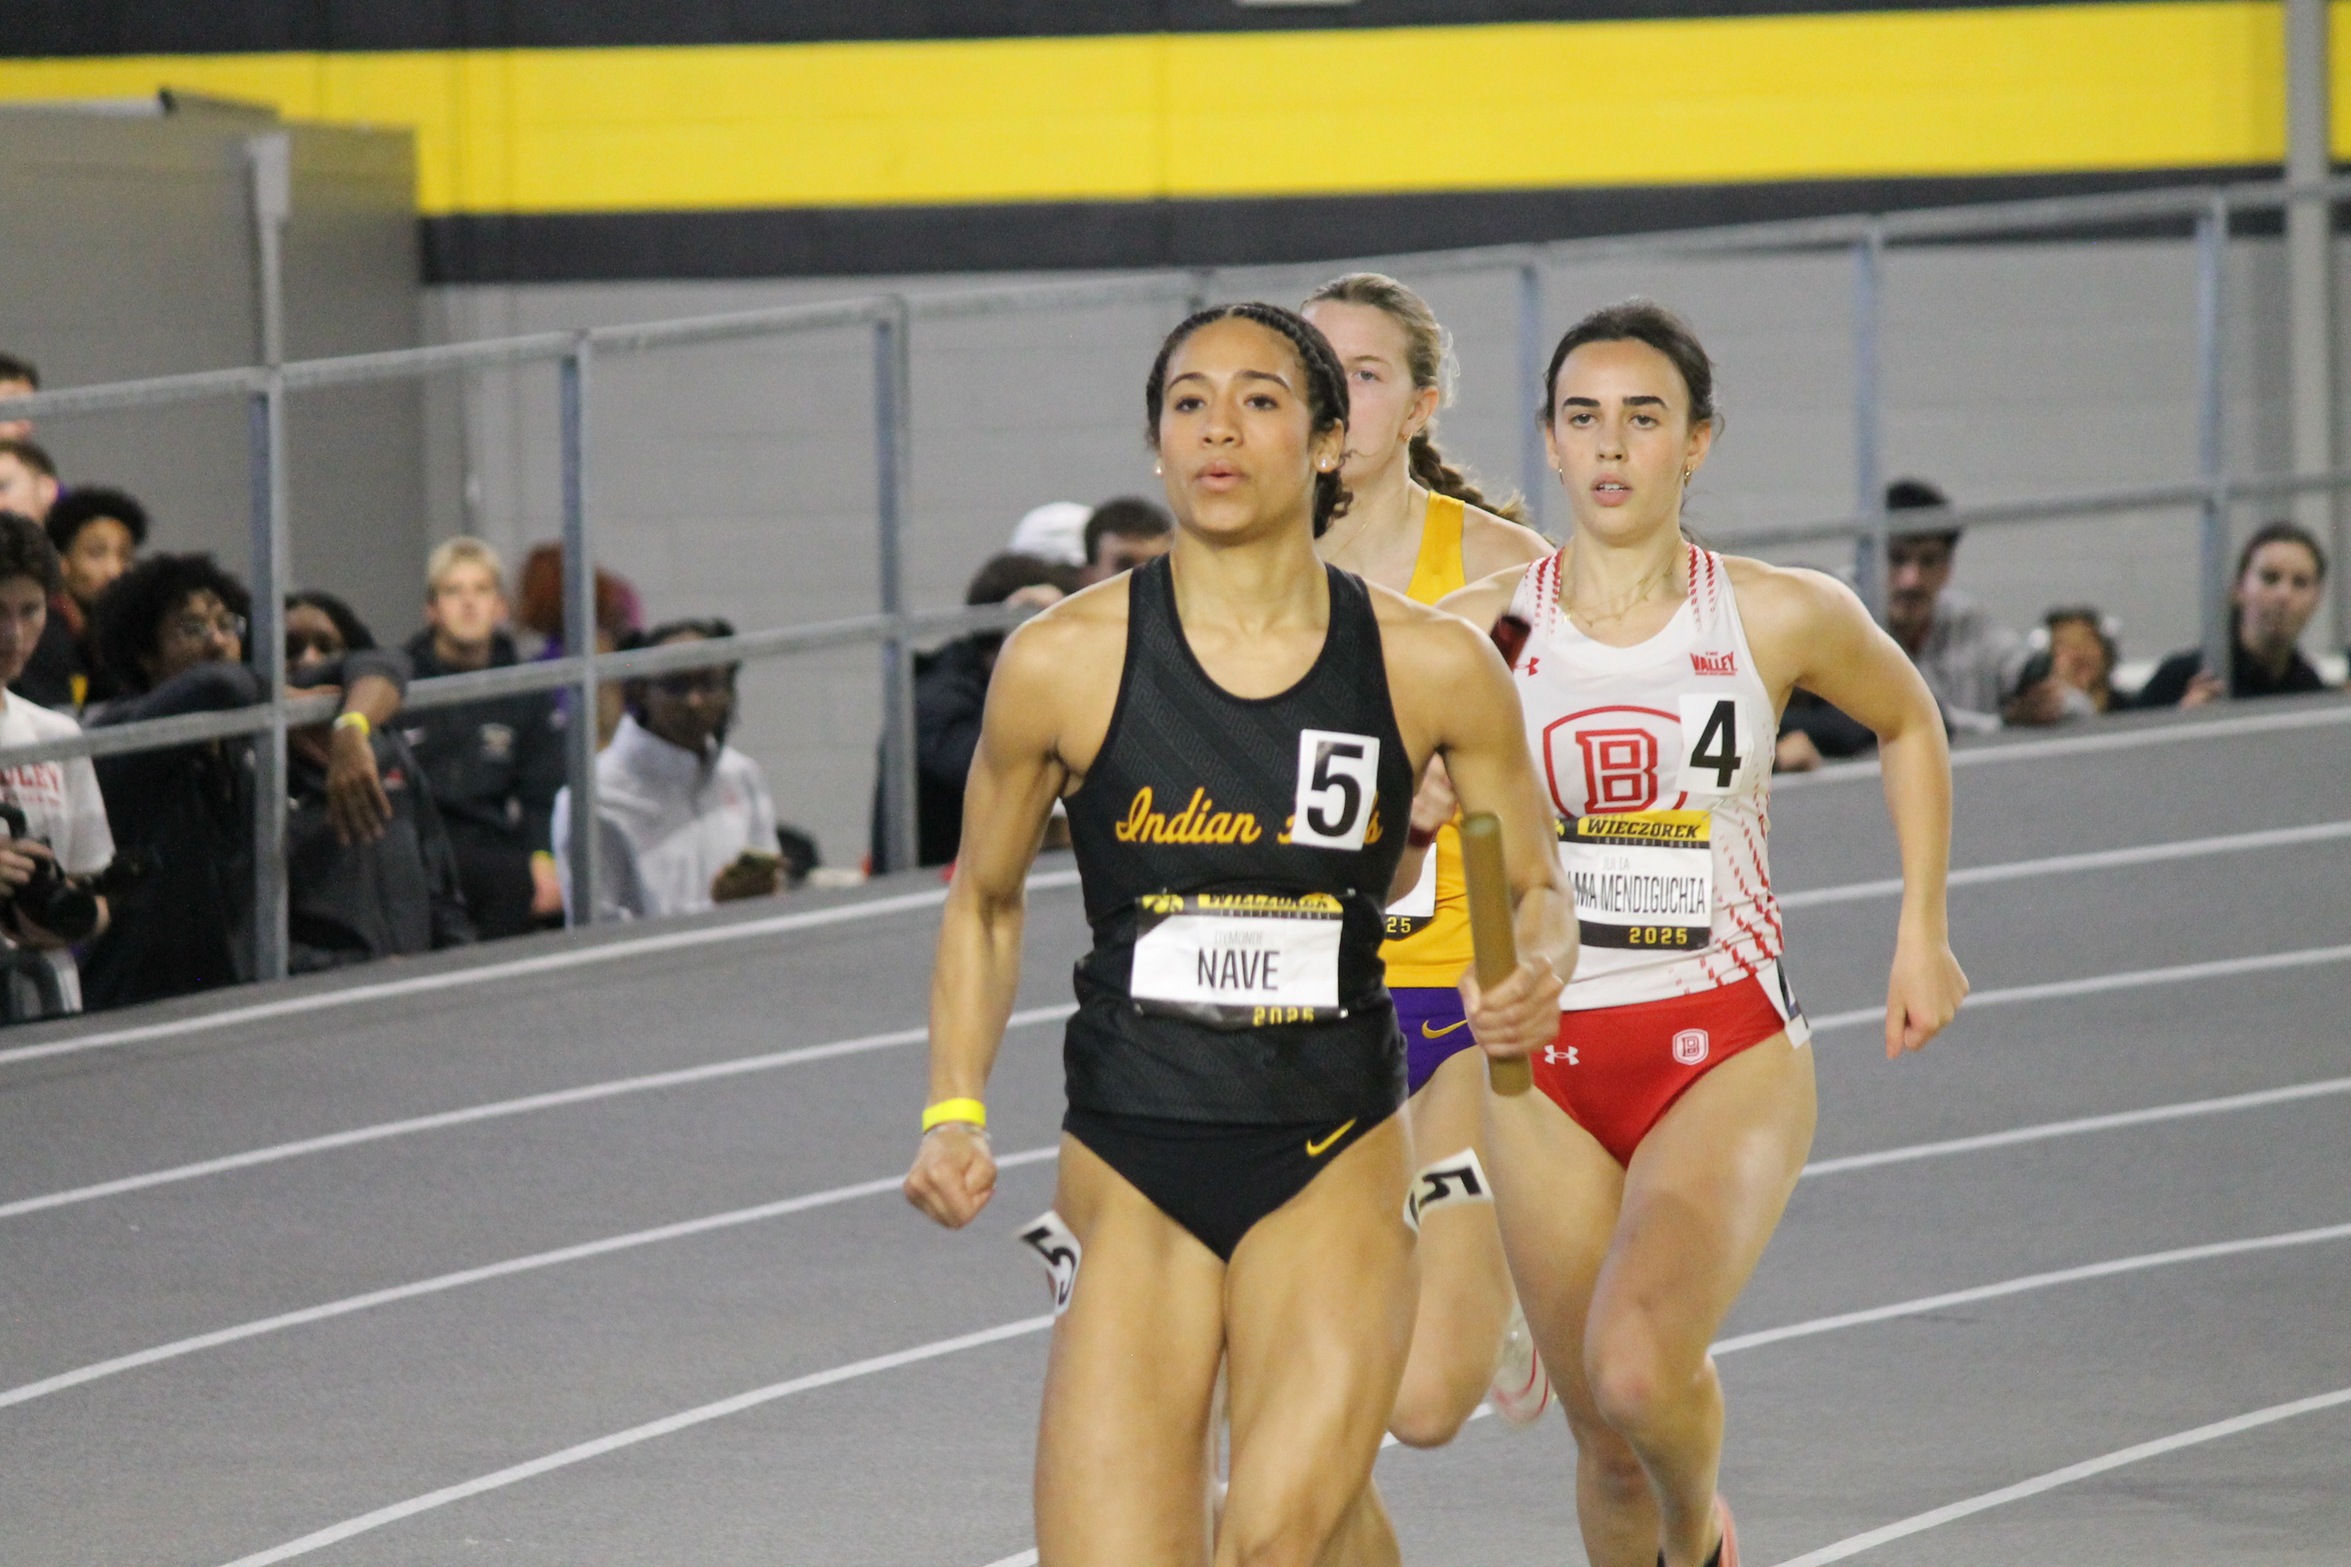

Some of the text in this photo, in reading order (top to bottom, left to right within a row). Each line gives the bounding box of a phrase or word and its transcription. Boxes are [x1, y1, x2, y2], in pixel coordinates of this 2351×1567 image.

[1690, 650, 1738, 671] VALLEY
[1689, 700, 1741, 788] 4
[1307, 740, 1364, 837] 5
[1115, 786, 1262, 844] Indian
[1587, 818, 1701, 839] WIECZOREK
[1601, 874, 1706, 915] MENDIGUCHIA
[1629, 927, 1688, 945] 2025
[1197, 948, 1280, 991] NAVE
